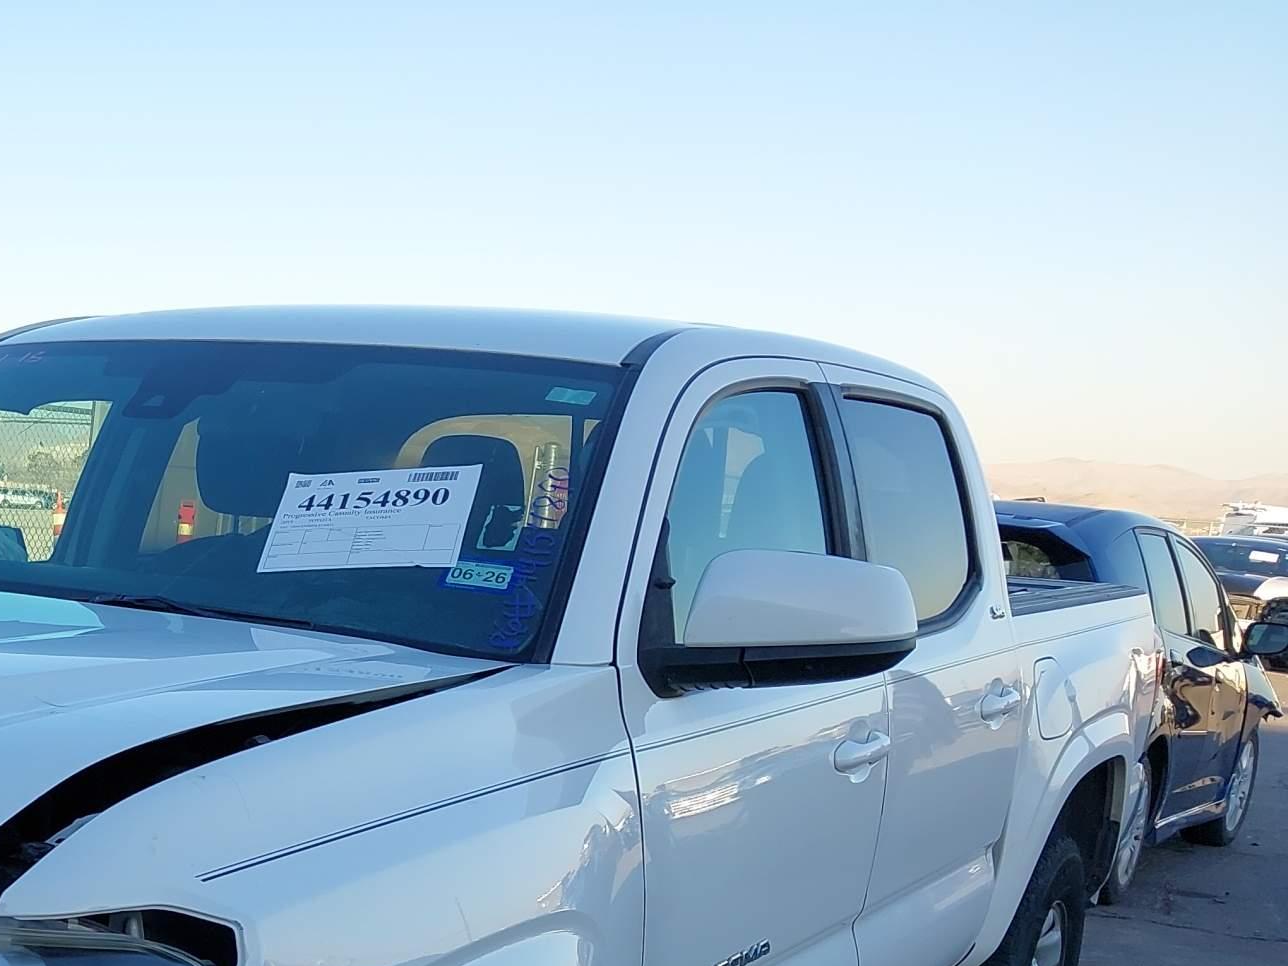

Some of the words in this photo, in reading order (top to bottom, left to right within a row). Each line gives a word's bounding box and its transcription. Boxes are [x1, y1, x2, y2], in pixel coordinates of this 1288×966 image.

[298, 487, 450, 512] 44154890
[283, 511, 327, 520] Progressive
[328, 510, 361, 518] Casualty
[364, 508, 402, 516] Insurance
